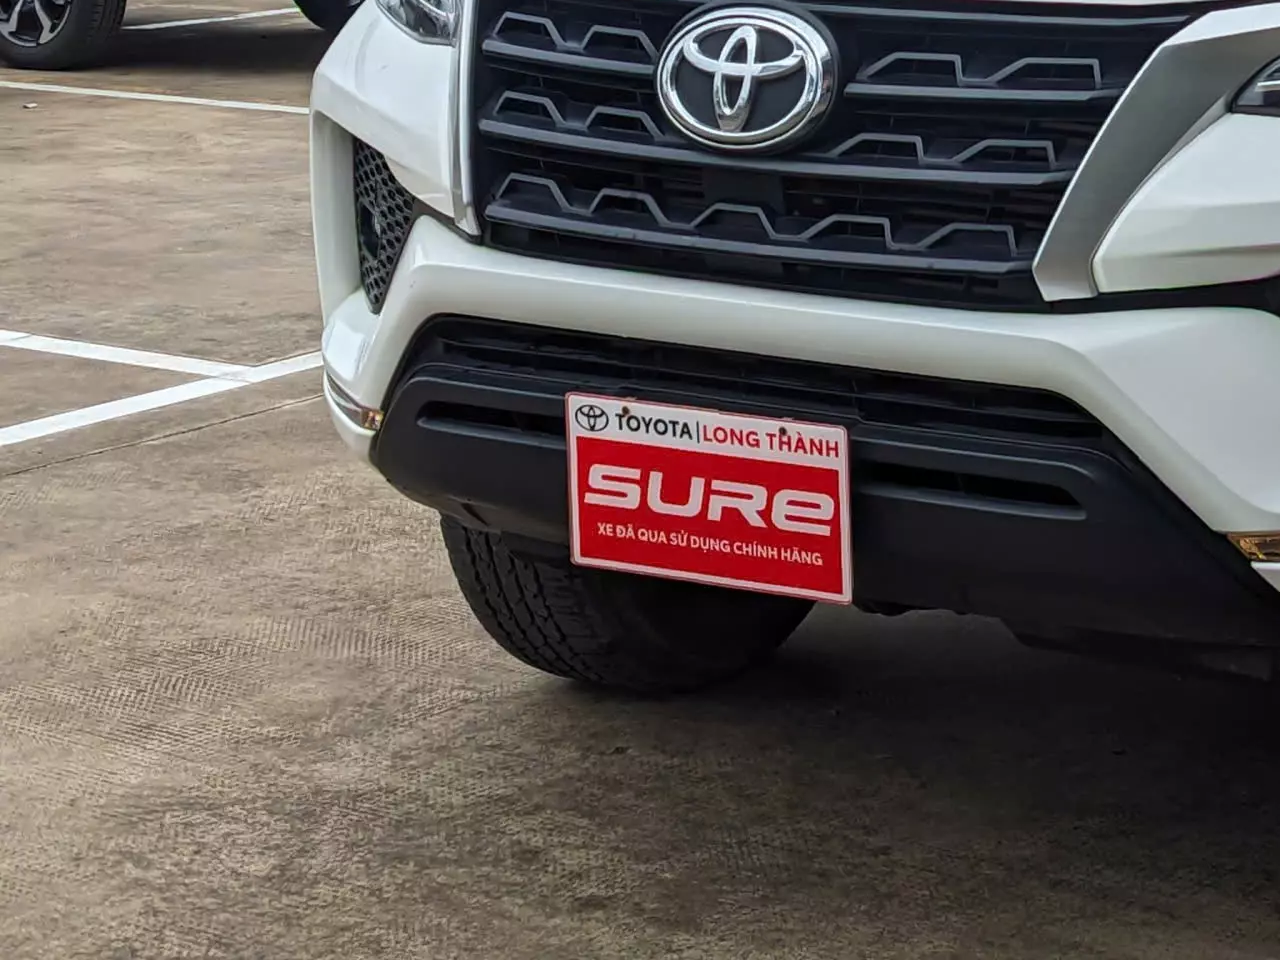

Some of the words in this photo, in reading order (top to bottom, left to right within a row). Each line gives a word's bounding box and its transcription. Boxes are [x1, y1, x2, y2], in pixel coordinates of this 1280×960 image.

[614, 412, 693, 440] TOYOTA
[702, 424, 760, 449] LONG
[765, 431, 840, 458] THÀNH
[597, 522, 614, 537] XE
[616, 523, 636, 540] ĐÃ
[637, 528, 668, 545] QUA
[669, 530, 689, 547] SỬ
[690, 535, 731, 554] DỤNG
[733, 541, 778, 560] CHÍNH
[780, 547, 823, 566] HÃNG
